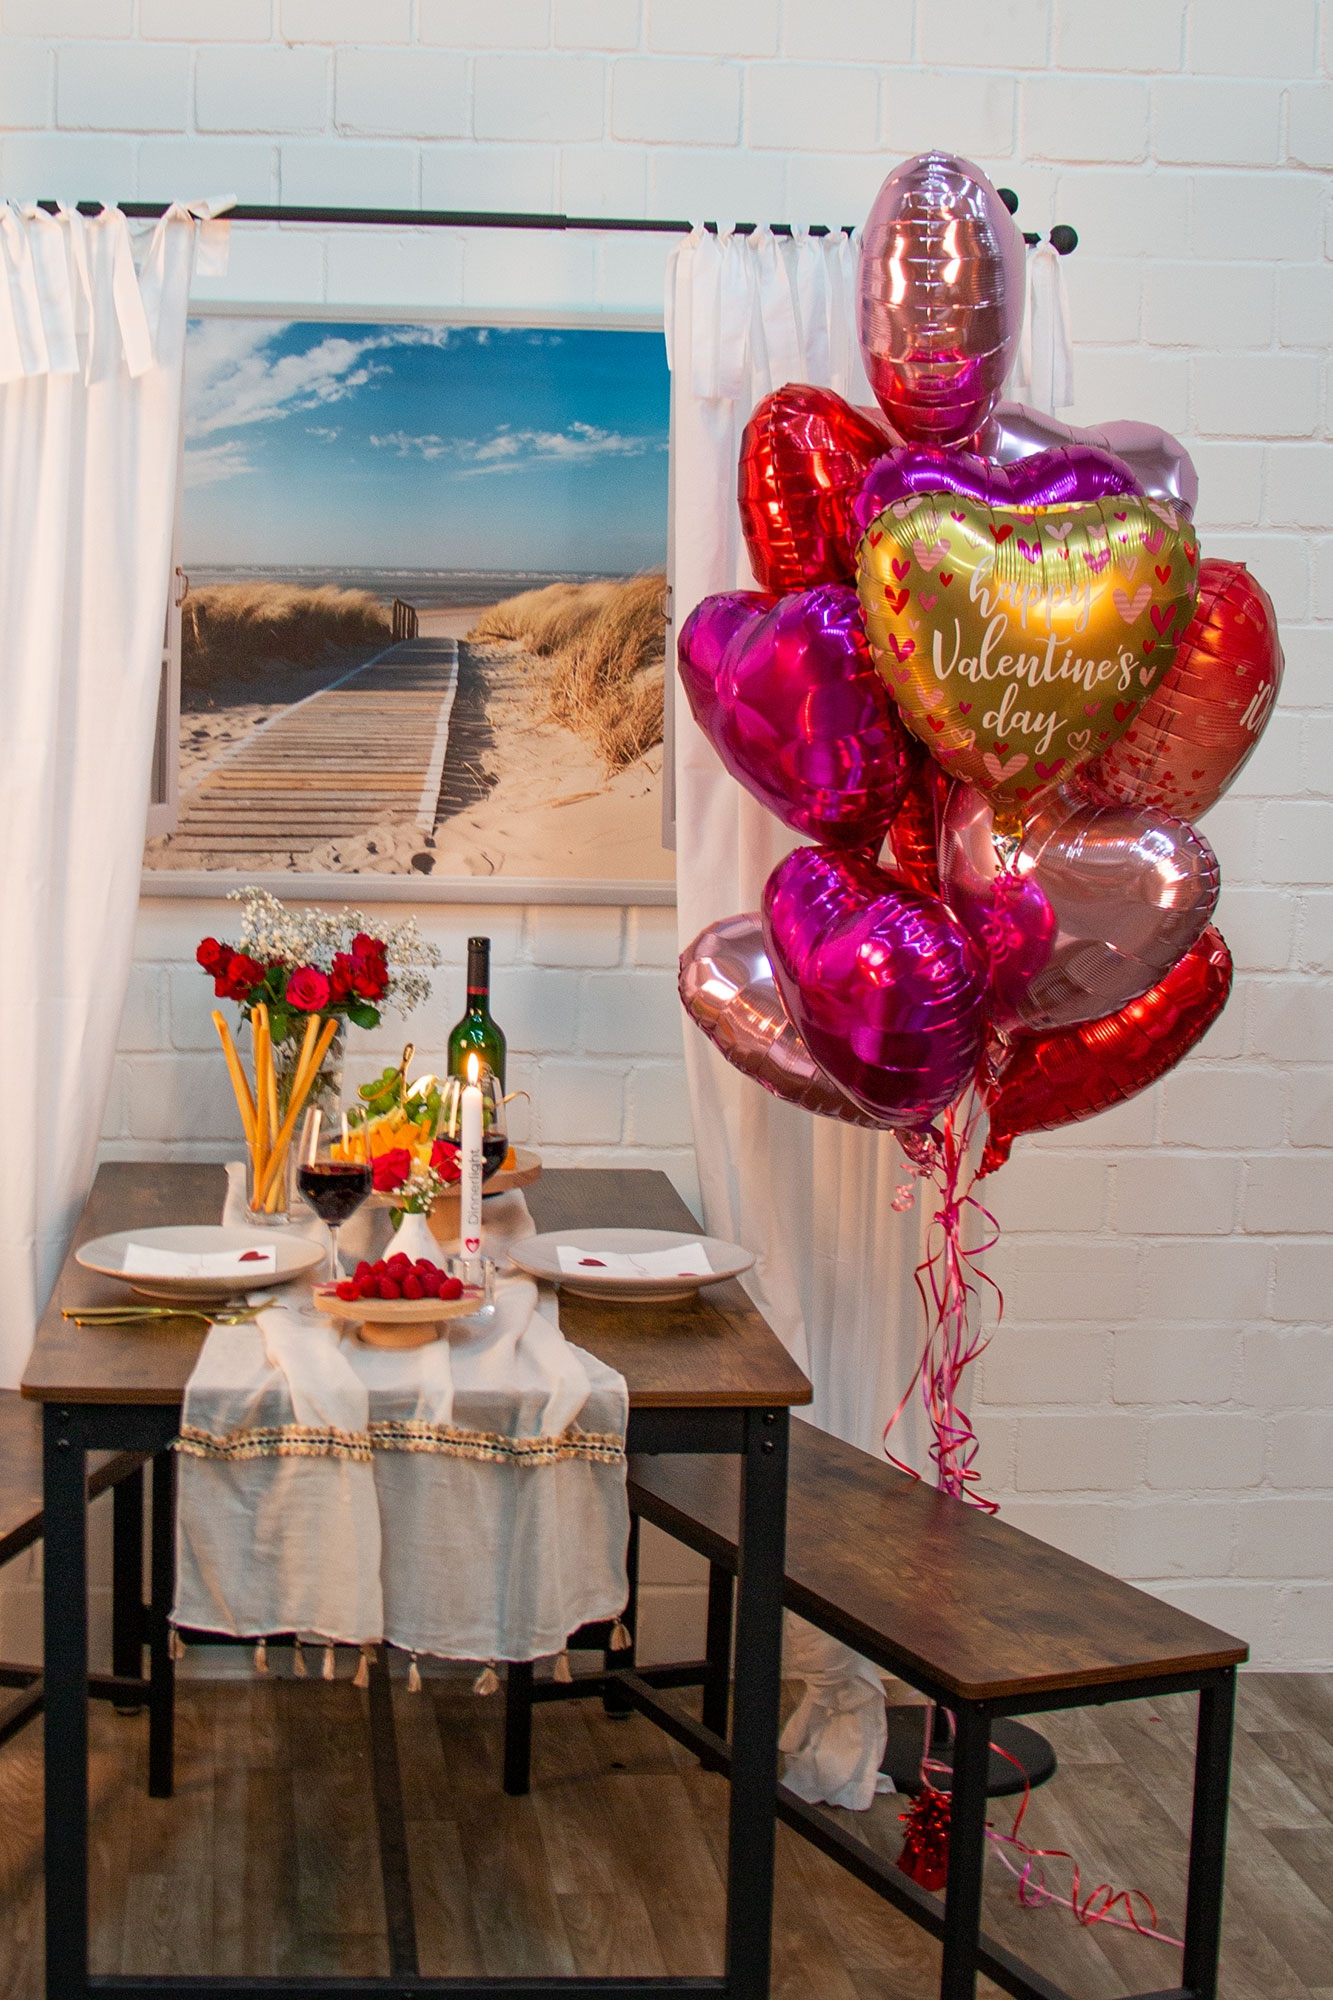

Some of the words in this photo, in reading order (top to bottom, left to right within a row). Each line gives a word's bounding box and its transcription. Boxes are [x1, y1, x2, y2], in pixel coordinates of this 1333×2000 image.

[969, 554, 1104, 633] happy
[932, 613, 1140, 691] Valentine's
[982, 683, 1068, 755] day
[468, 1149, 482, 1225] Dinnerlight
